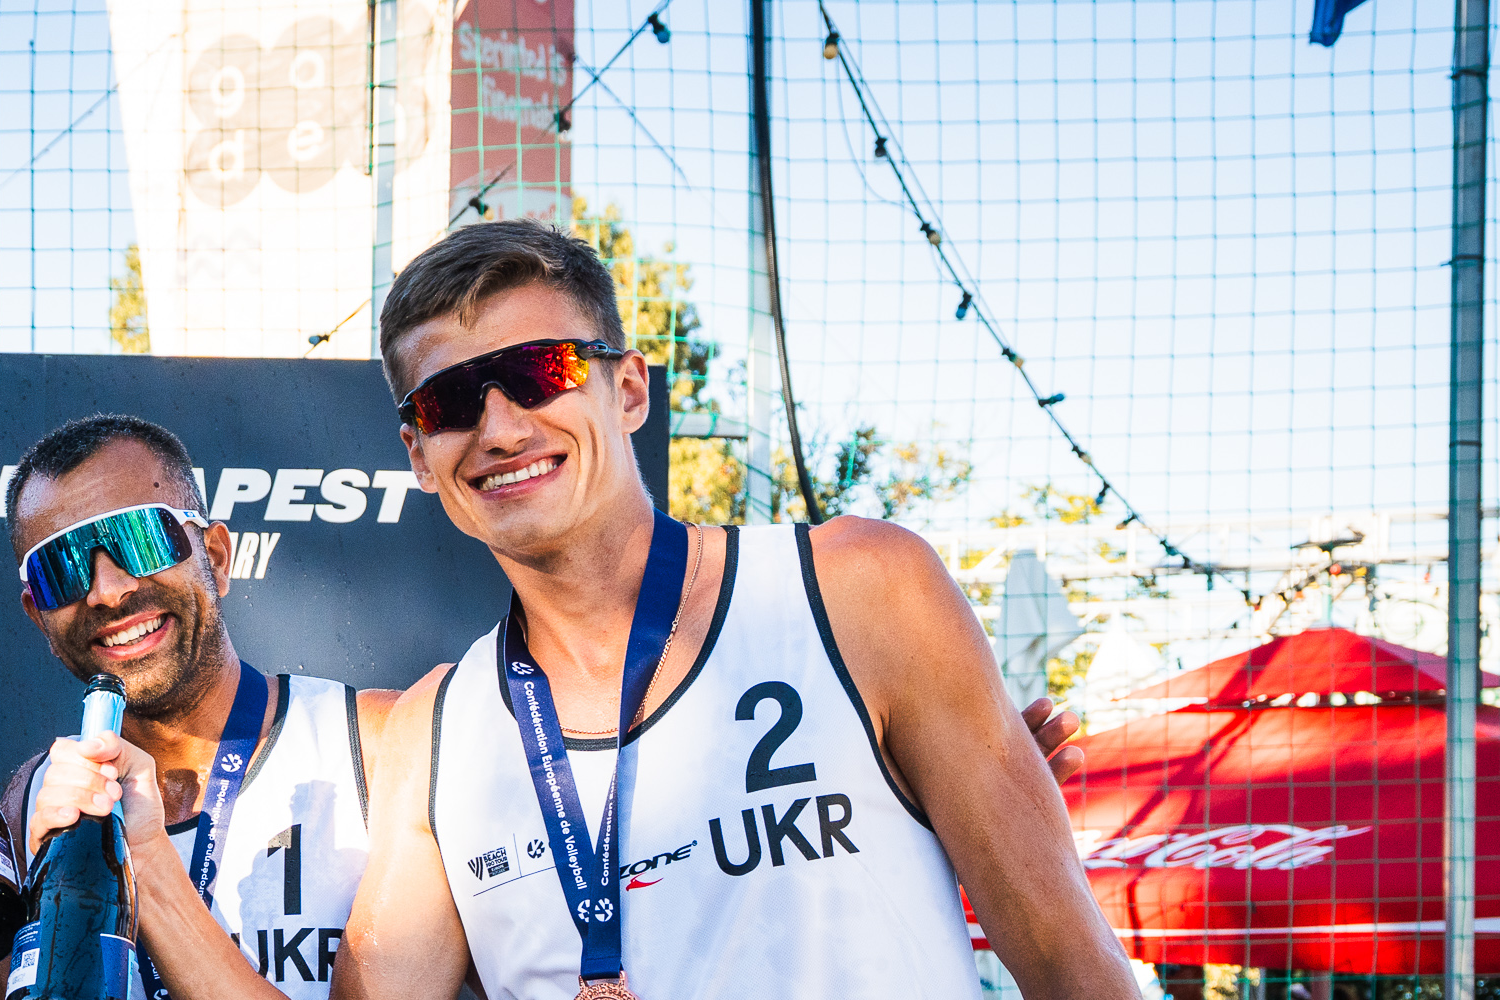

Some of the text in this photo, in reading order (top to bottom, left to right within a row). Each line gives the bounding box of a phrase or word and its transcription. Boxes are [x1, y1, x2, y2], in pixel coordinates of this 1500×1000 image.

[524, 681, 588, 891] Confédération Européenne de Volleyball
[735, 681, 817, 794] 2
[199, 842, 215, 900] uropéenne
[210, 779, 231, 828] Volleyball
[267, 824, 303, 916] 1
[483, 849, 507, 863] BEACH
[708, 793, 860, 877] UKR
